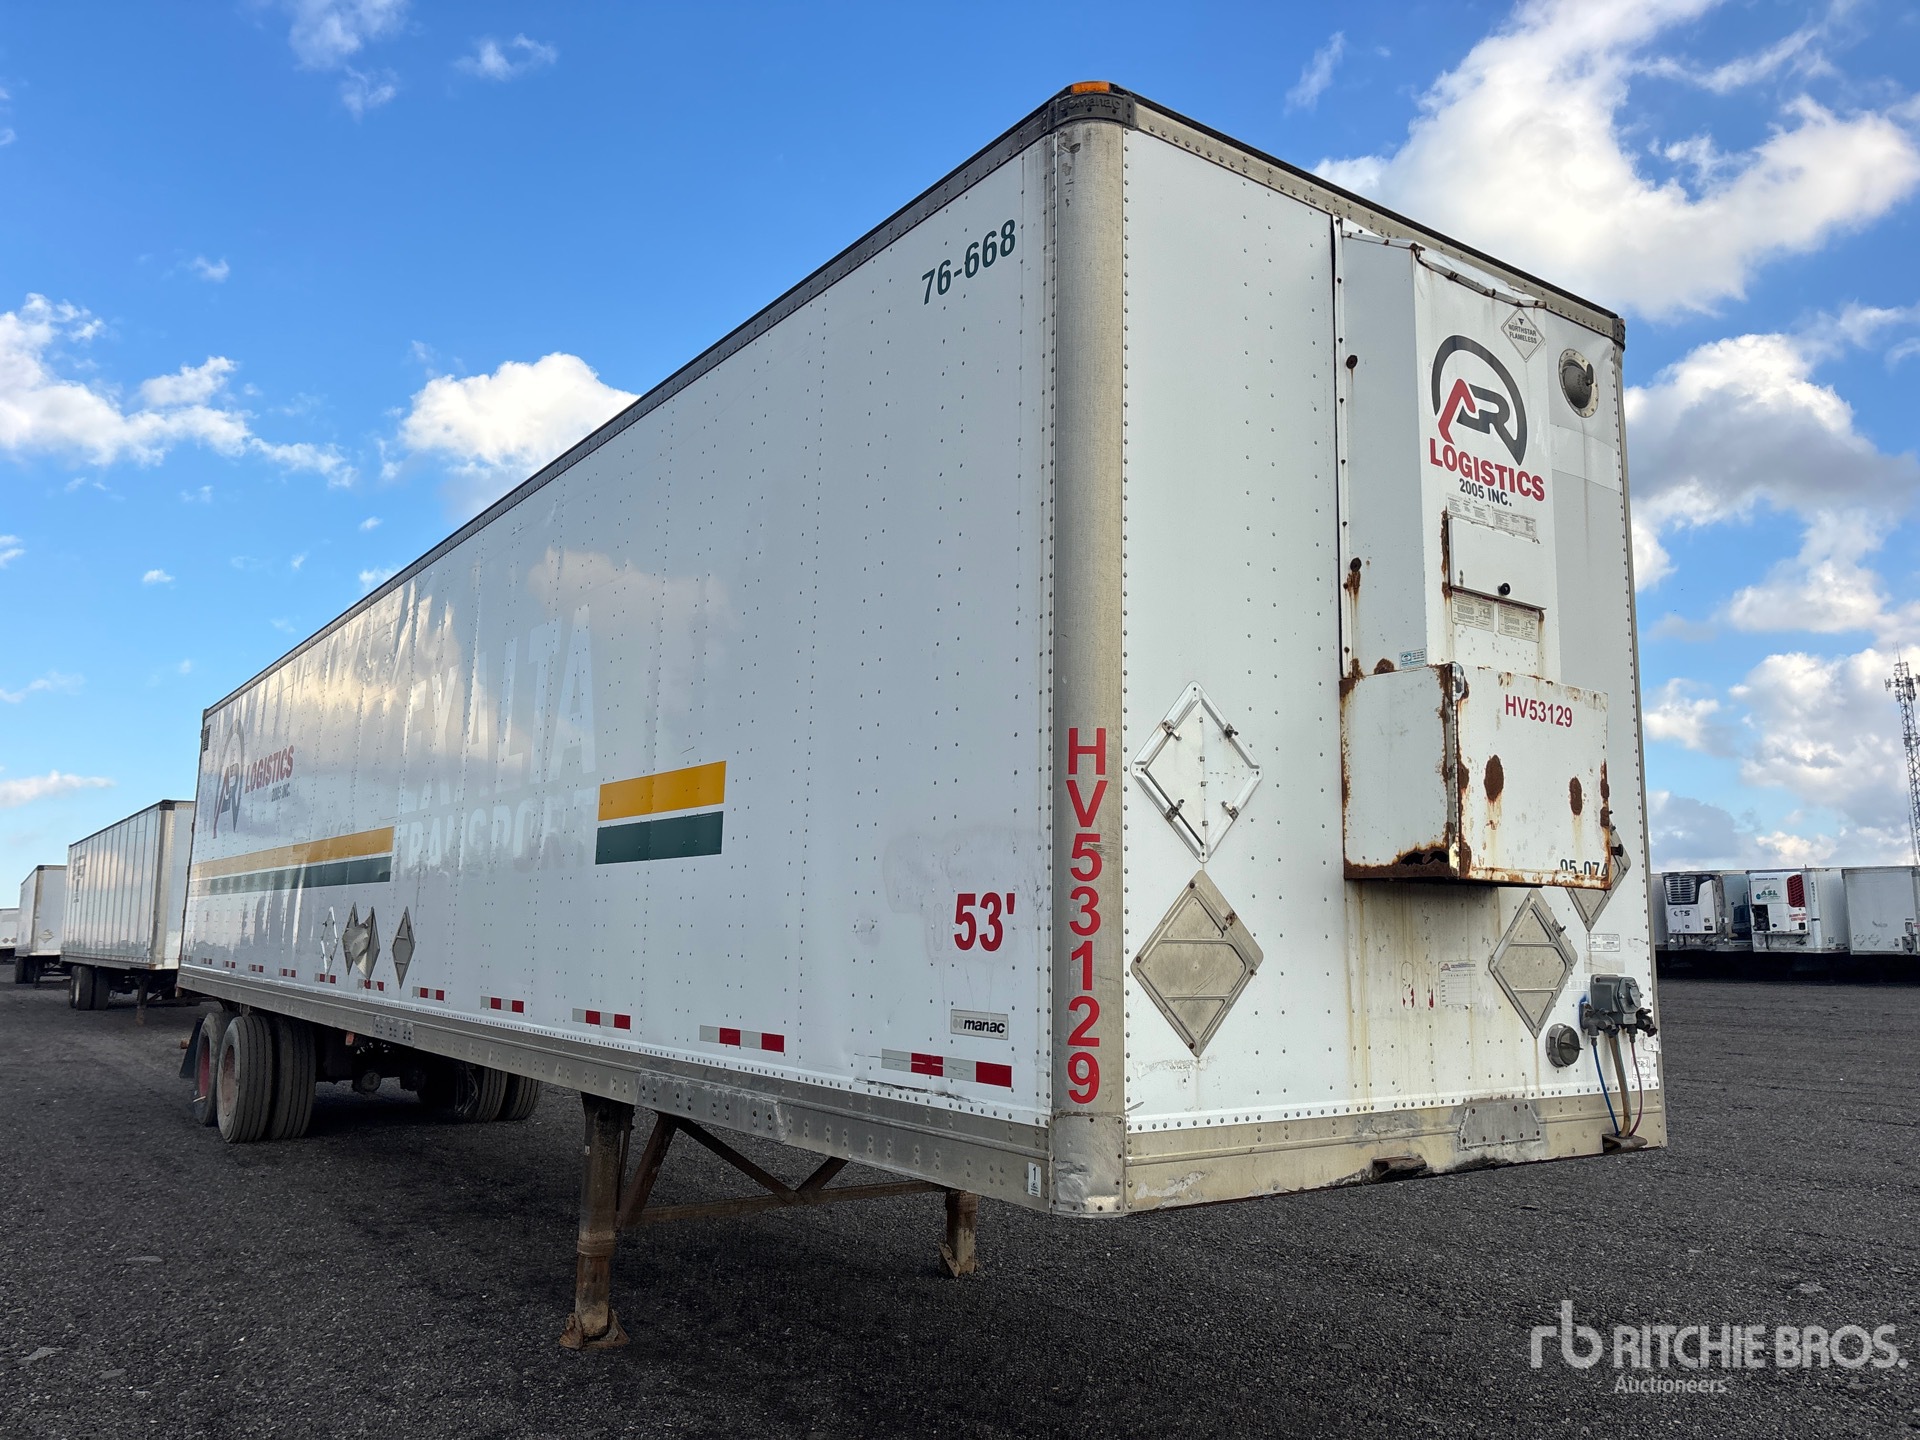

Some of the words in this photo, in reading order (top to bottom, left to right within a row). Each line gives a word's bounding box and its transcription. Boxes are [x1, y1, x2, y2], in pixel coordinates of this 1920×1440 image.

[921, 219, 1016, 305] 76-668
[1507, 324, 1537, 337] NORTHSTAR
[1509, 331, 1538, 344] FLAMELESS
[1429, 437, 1545, 502] LOGISTICS
[1459, 478, 1485, 500] 2005
[1487, 488, 1512, 507] INC.
[1505, 694, 1573, 728] HV53129
[245, 745, 294, 794] LOGISTICS
[953, 892, 1016, 952] 53'
[1066, 727, 1109, 1104] HV53129
[963, 1018, 1005, 1034] manac
